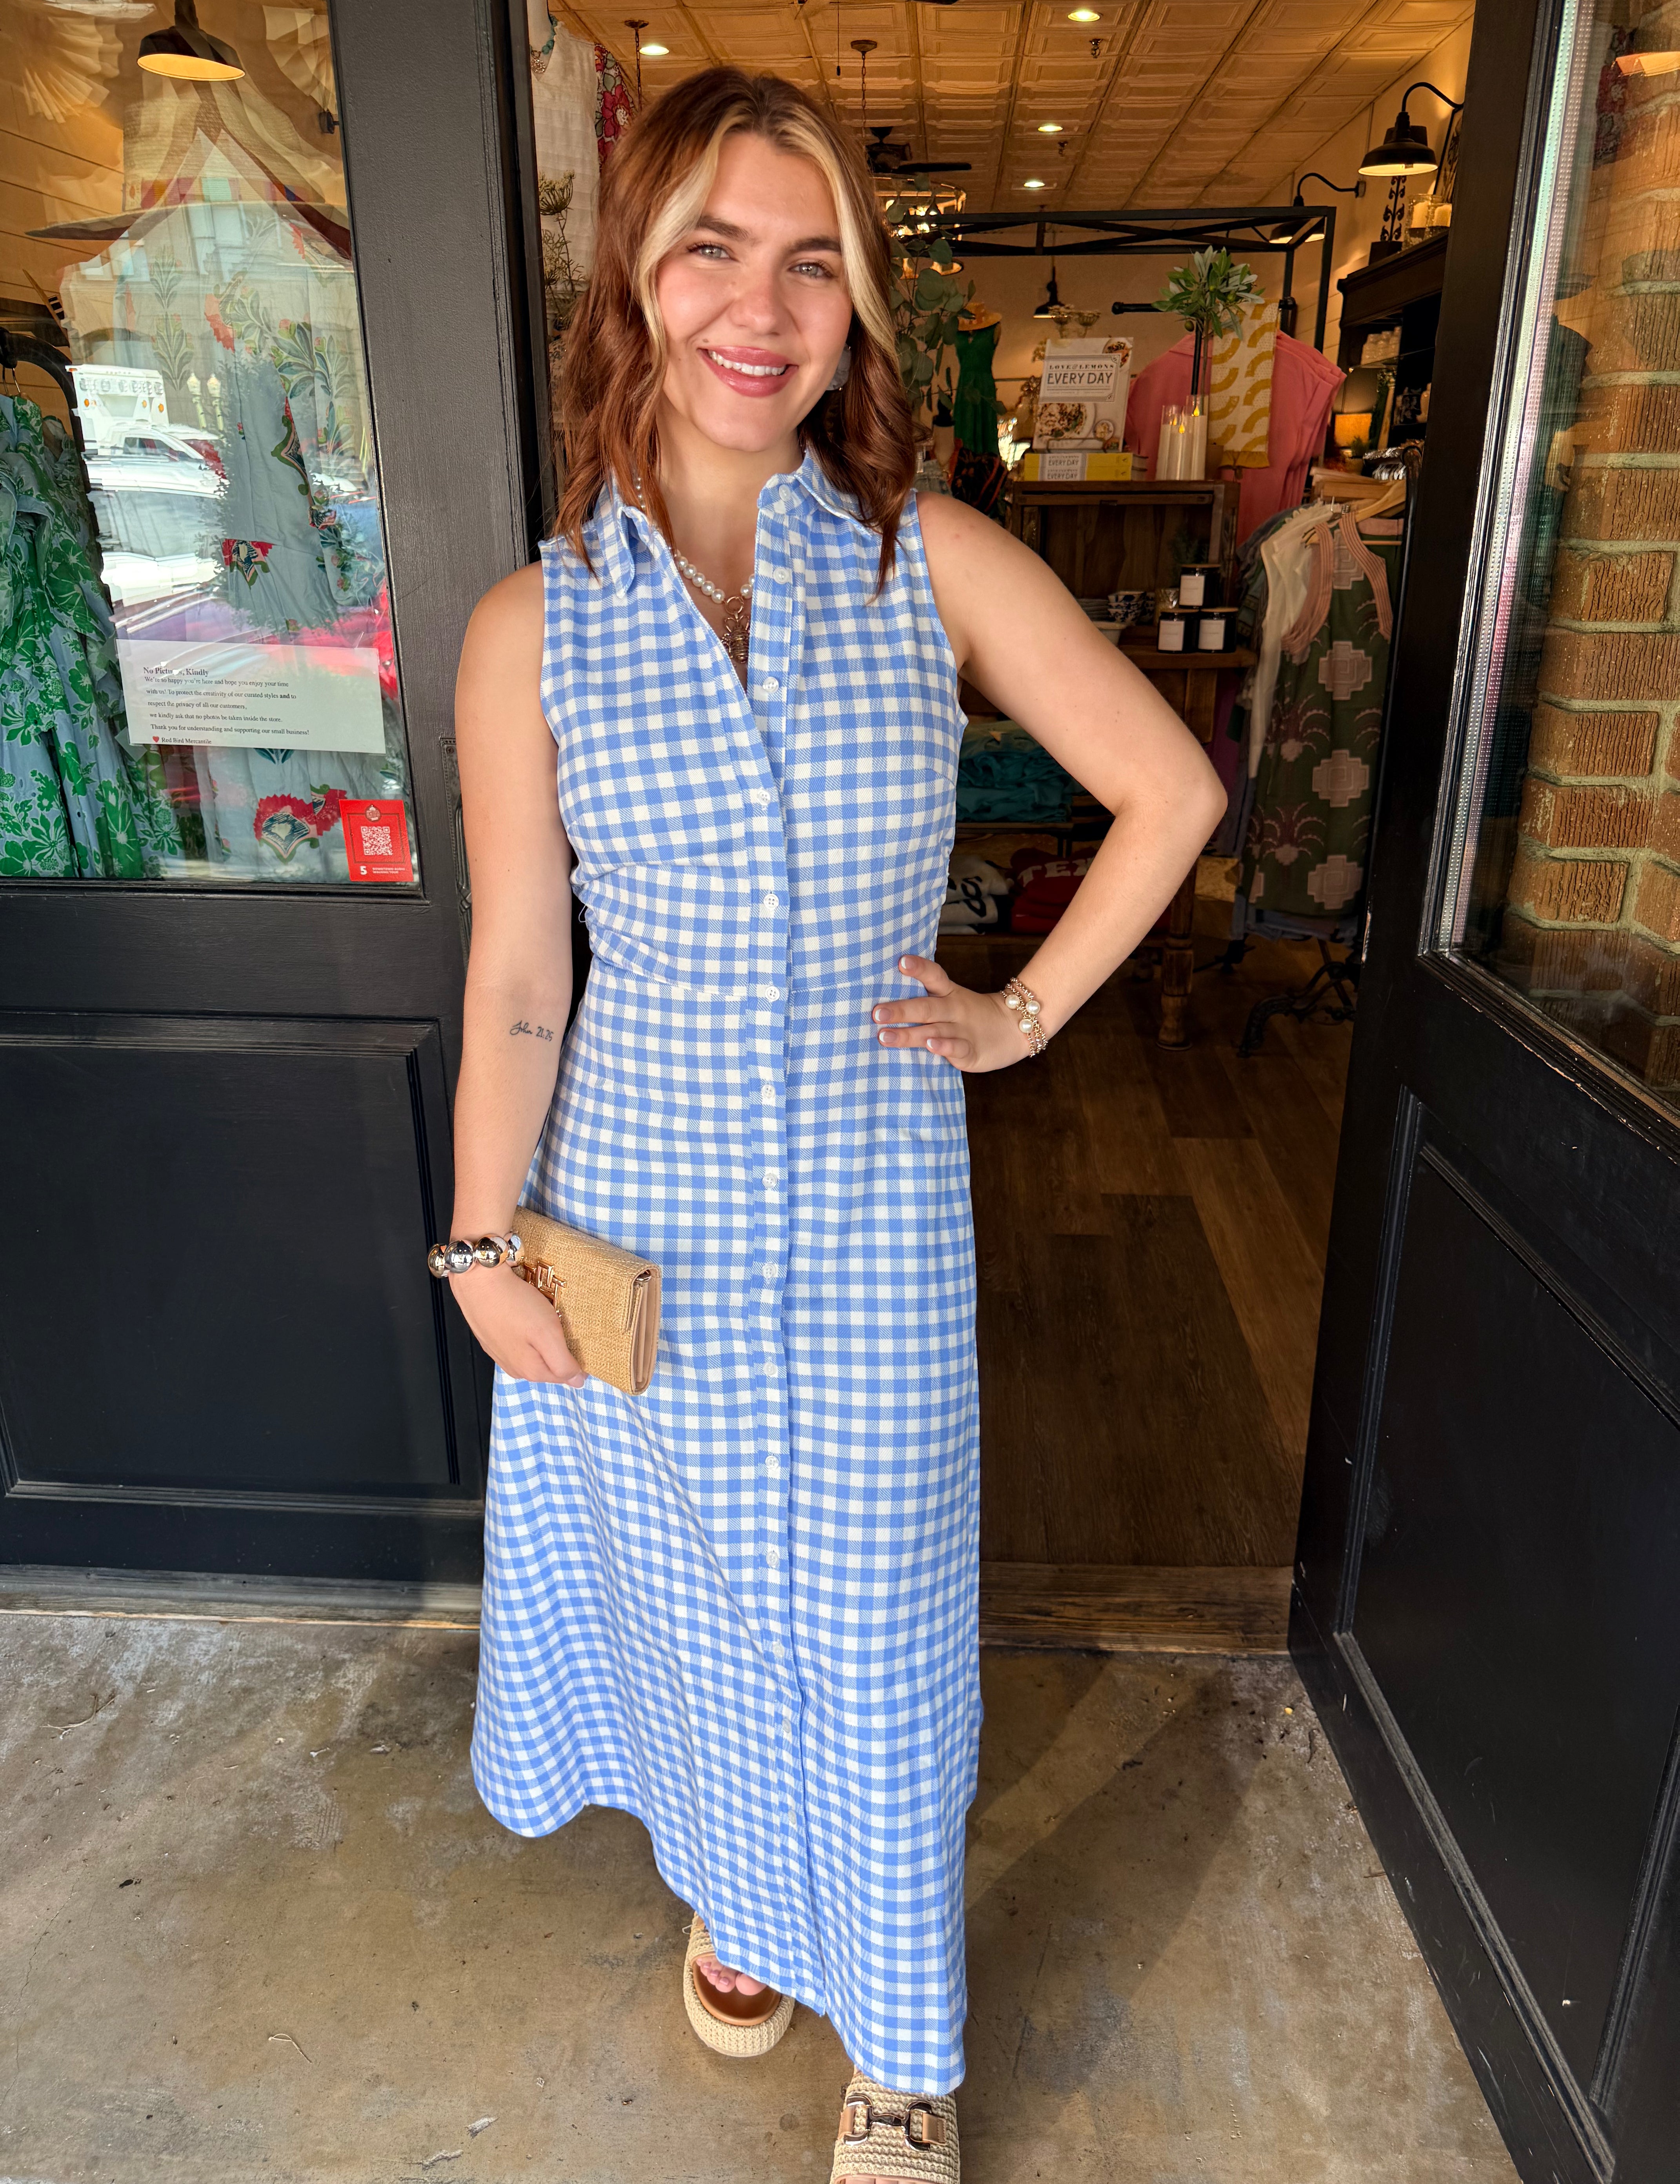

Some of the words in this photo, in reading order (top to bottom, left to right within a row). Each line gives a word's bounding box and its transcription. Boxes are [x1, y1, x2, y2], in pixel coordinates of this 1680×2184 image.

[1047, 373, 1085, 384] EVERY
[1087, 373, 1112, 384] DAY
[186, 668, 209, 677] Kindly
[360, 866, 367, 875] 5
[510, 1020, 533, 1035] John
